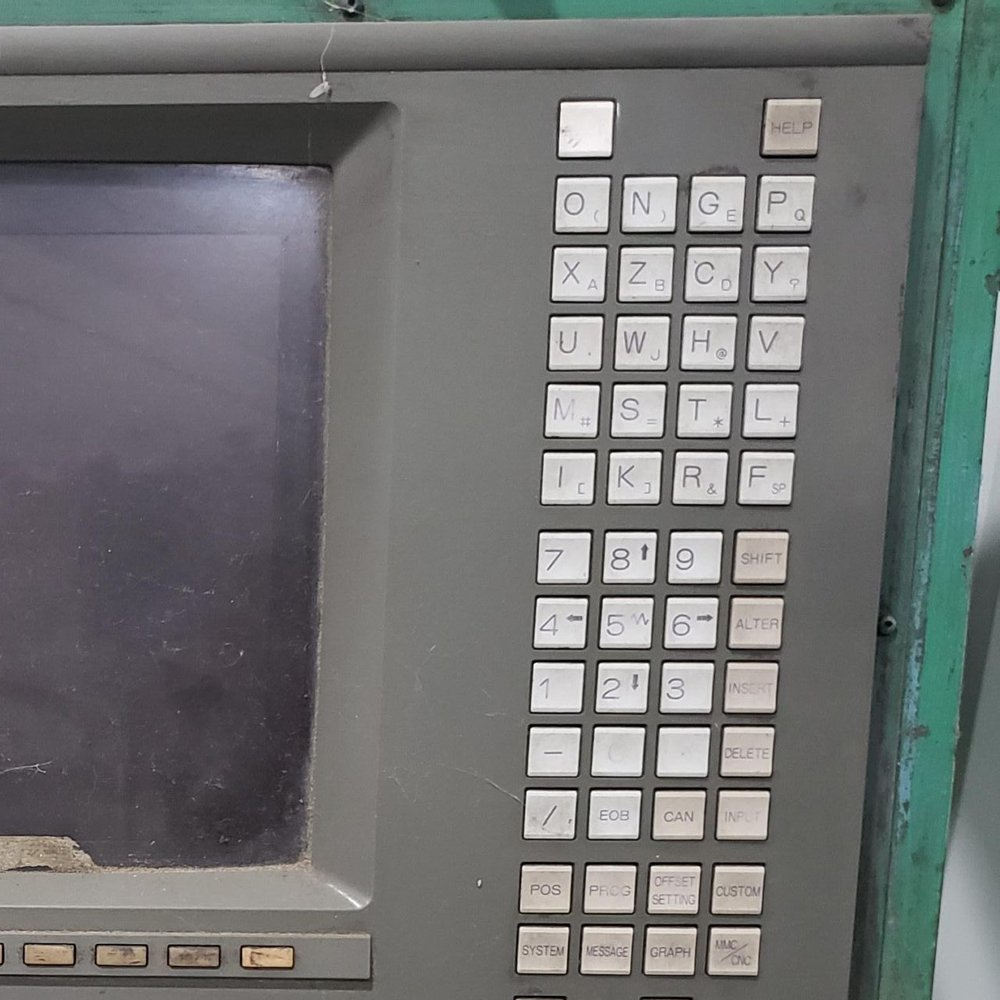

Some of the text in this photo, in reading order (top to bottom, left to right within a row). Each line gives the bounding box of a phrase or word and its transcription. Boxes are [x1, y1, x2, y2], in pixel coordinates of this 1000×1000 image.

[770, 121, 813, 135] HELP
[631, 191, 651, 216] N
[697, 191, 720, 216] G
[766, 190, 788, 215] P
[561, 261, 581, 285] X
[628, 261, 648, 285] Z
[694, 261, 715, 285] C
[763, 260, 784, 284] Y
[559, 330, 578, 354] U
[623, 330, 646, 354] W
[691, 329, 711, 353] H
[758, 330, 779, 353] V
[553, 397, 575, 422] M
[620, 397, 640, 422] S
[688, 398, 707, 422] T
[754, 398, 773, 421] L
[617, 465, 635, 488] K
[682, 465, 702, 489] R
[748, 465, 787, 495] F SP
[544, 549, 564, 572] 7
[610, 548, 630, 571] 8
[675, 548, 694, 571] 9
[740, 551, 783, 565] SHIFT
[539, 613, 559, 636] 4
[606, 613, 625, 637] 5
[671, 613, 691, 637] 6
[735, 617, 780, 631] ALTER
[538, 678, 550, 700] 1
[601, 678, 621, 700] 2
[666, 678, 685, 700] 3
[724, 747, 770, 760] DELETE
[599, 809, 630, 822] EOB
[663, 811, 695, 824] CAN
[529, 884, 561, 896] POS
[654, 875, 696, 888] OFFSET
[715, 885, 761, 898] CUSTOM
[652, 893, 696, 906] SETTING
[522, 944, 565, 957] SYSTEM
[586, 945, 629, 958] MESSAGE
[650, 946, 691, 958] GRAPH
